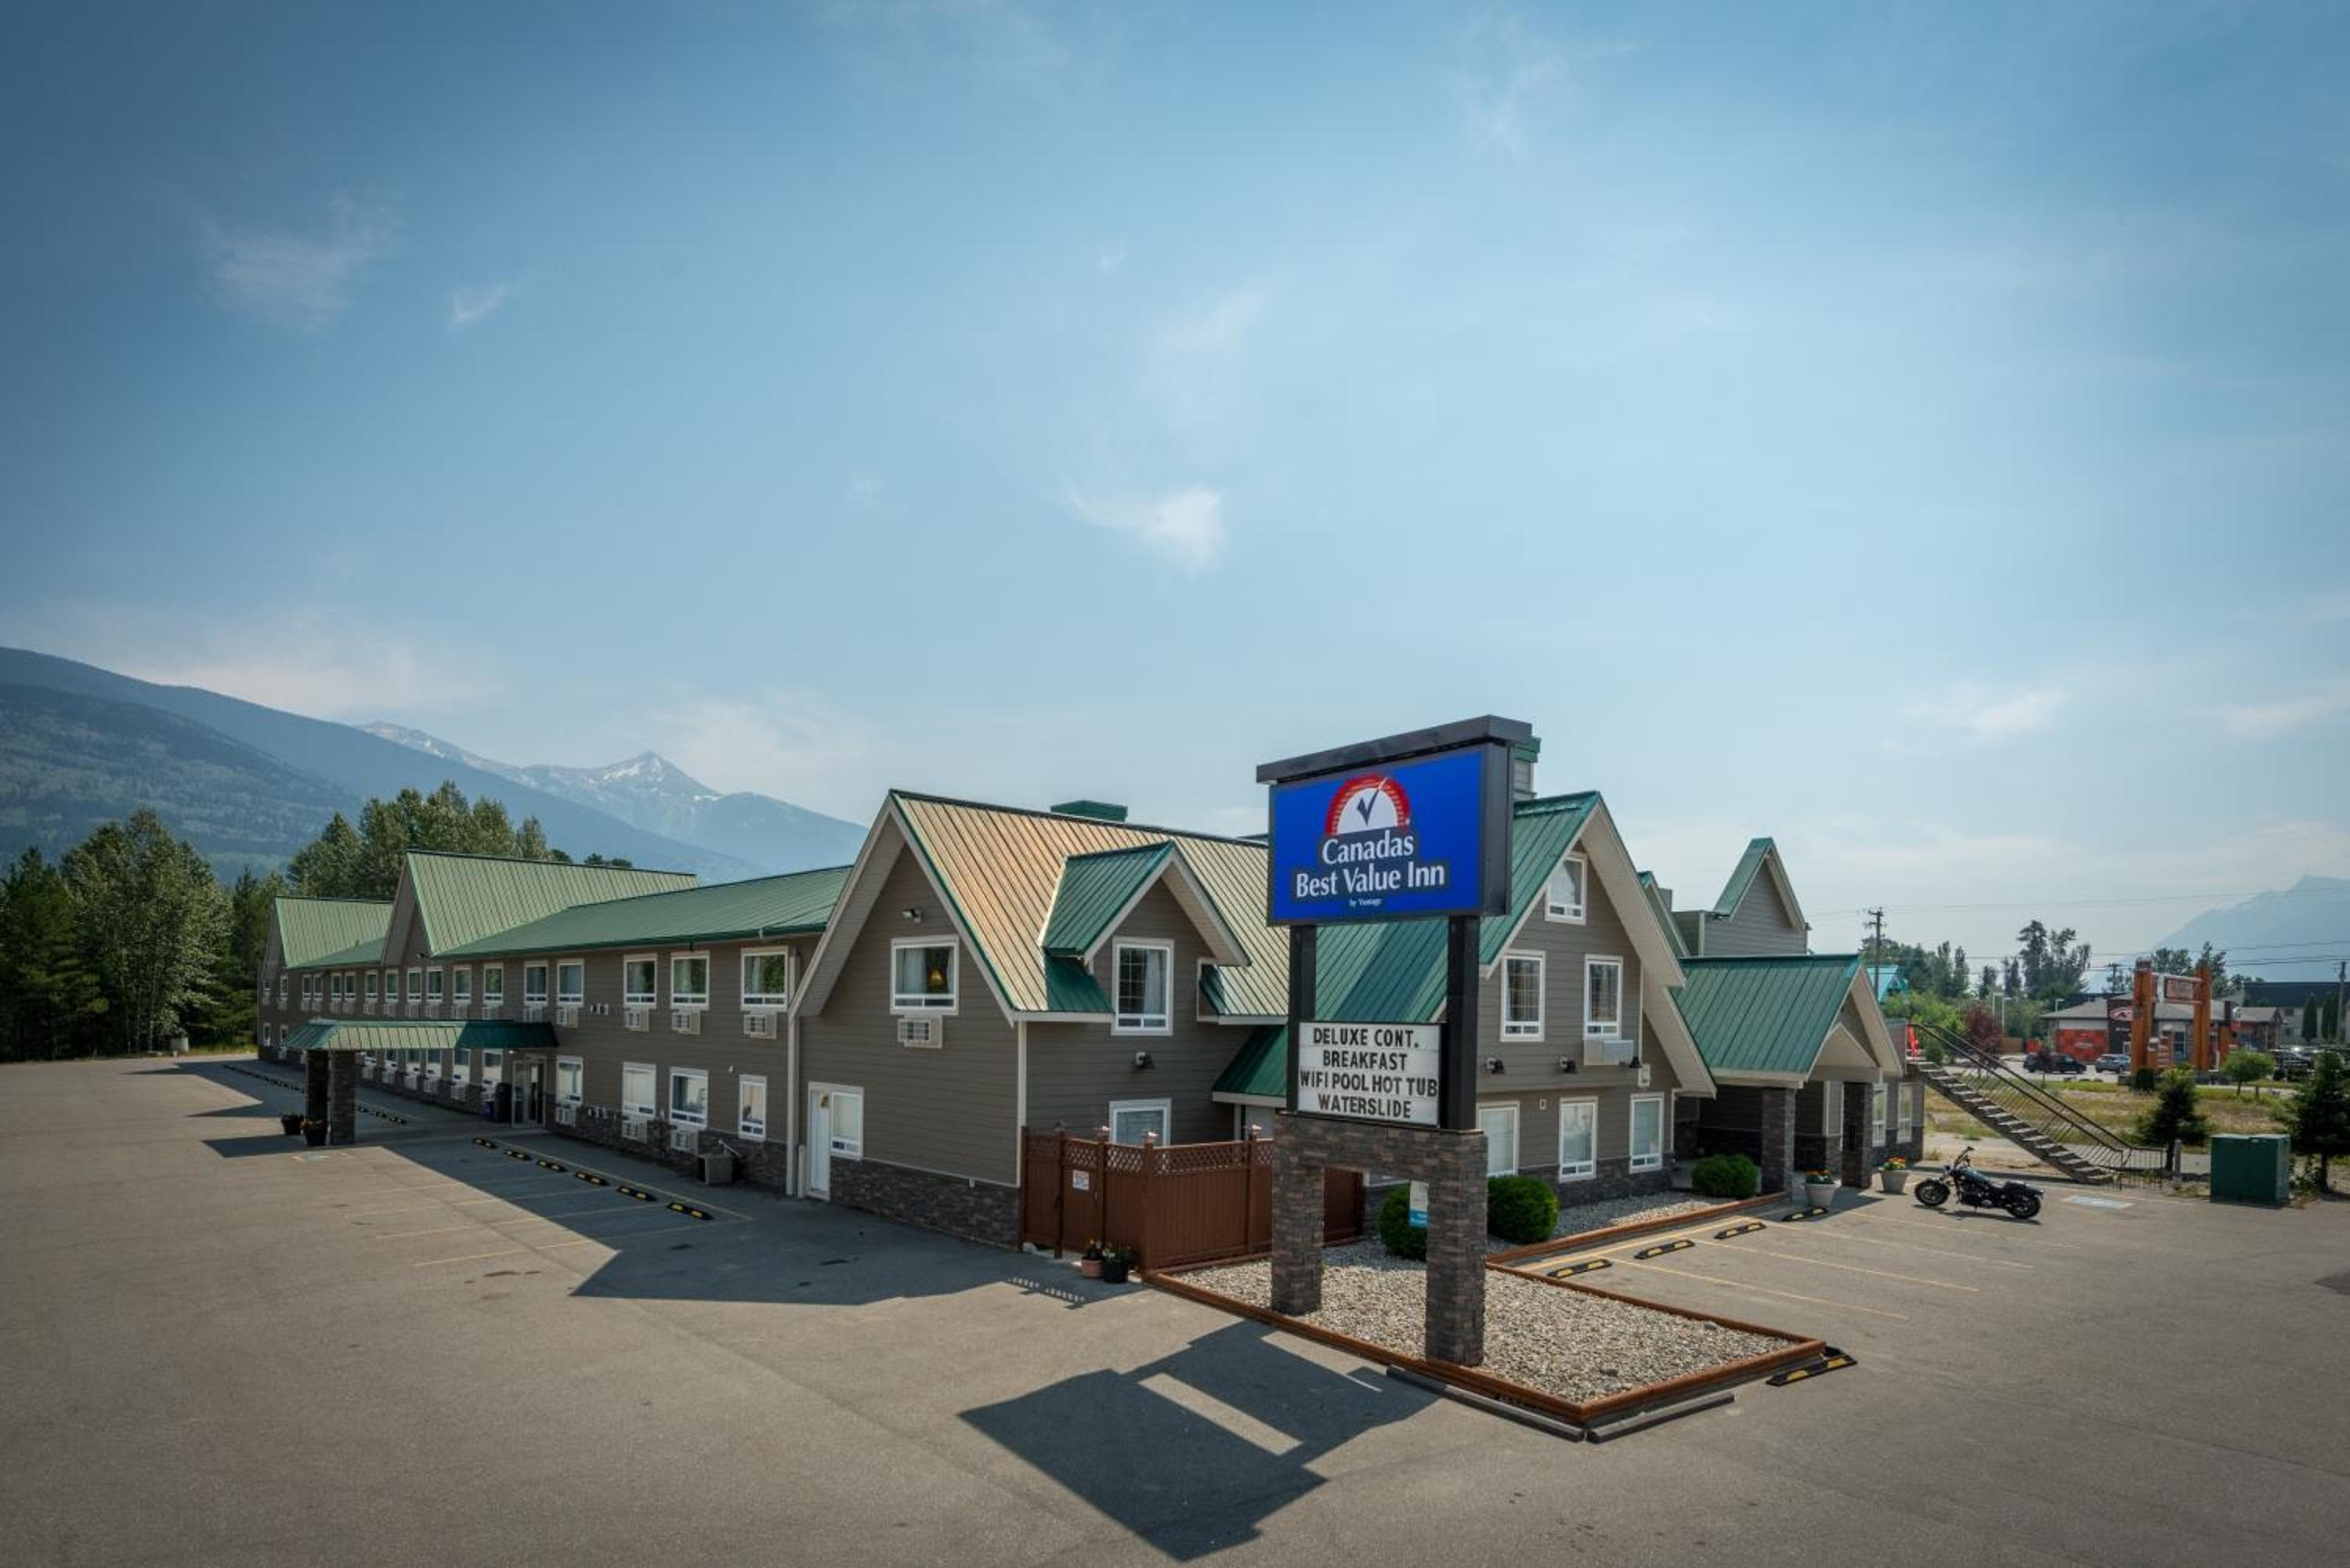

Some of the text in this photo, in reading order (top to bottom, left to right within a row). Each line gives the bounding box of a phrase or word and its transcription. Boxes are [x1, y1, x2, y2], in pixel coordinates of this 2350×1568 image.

[1322, 829, 1414, 865] Canadas
[1296, 861, 1444, 898] Best Value Inn
[1313, 1027, 1419, 1048] DELUXE CONT.
[1323, 1050, 1407, 1071] BREAKFAST
[1300, 1070, 1437, 1097] WIFI POOL HOT TUB
[1318, 1093, 1412, 1118] WATERSLIDE
